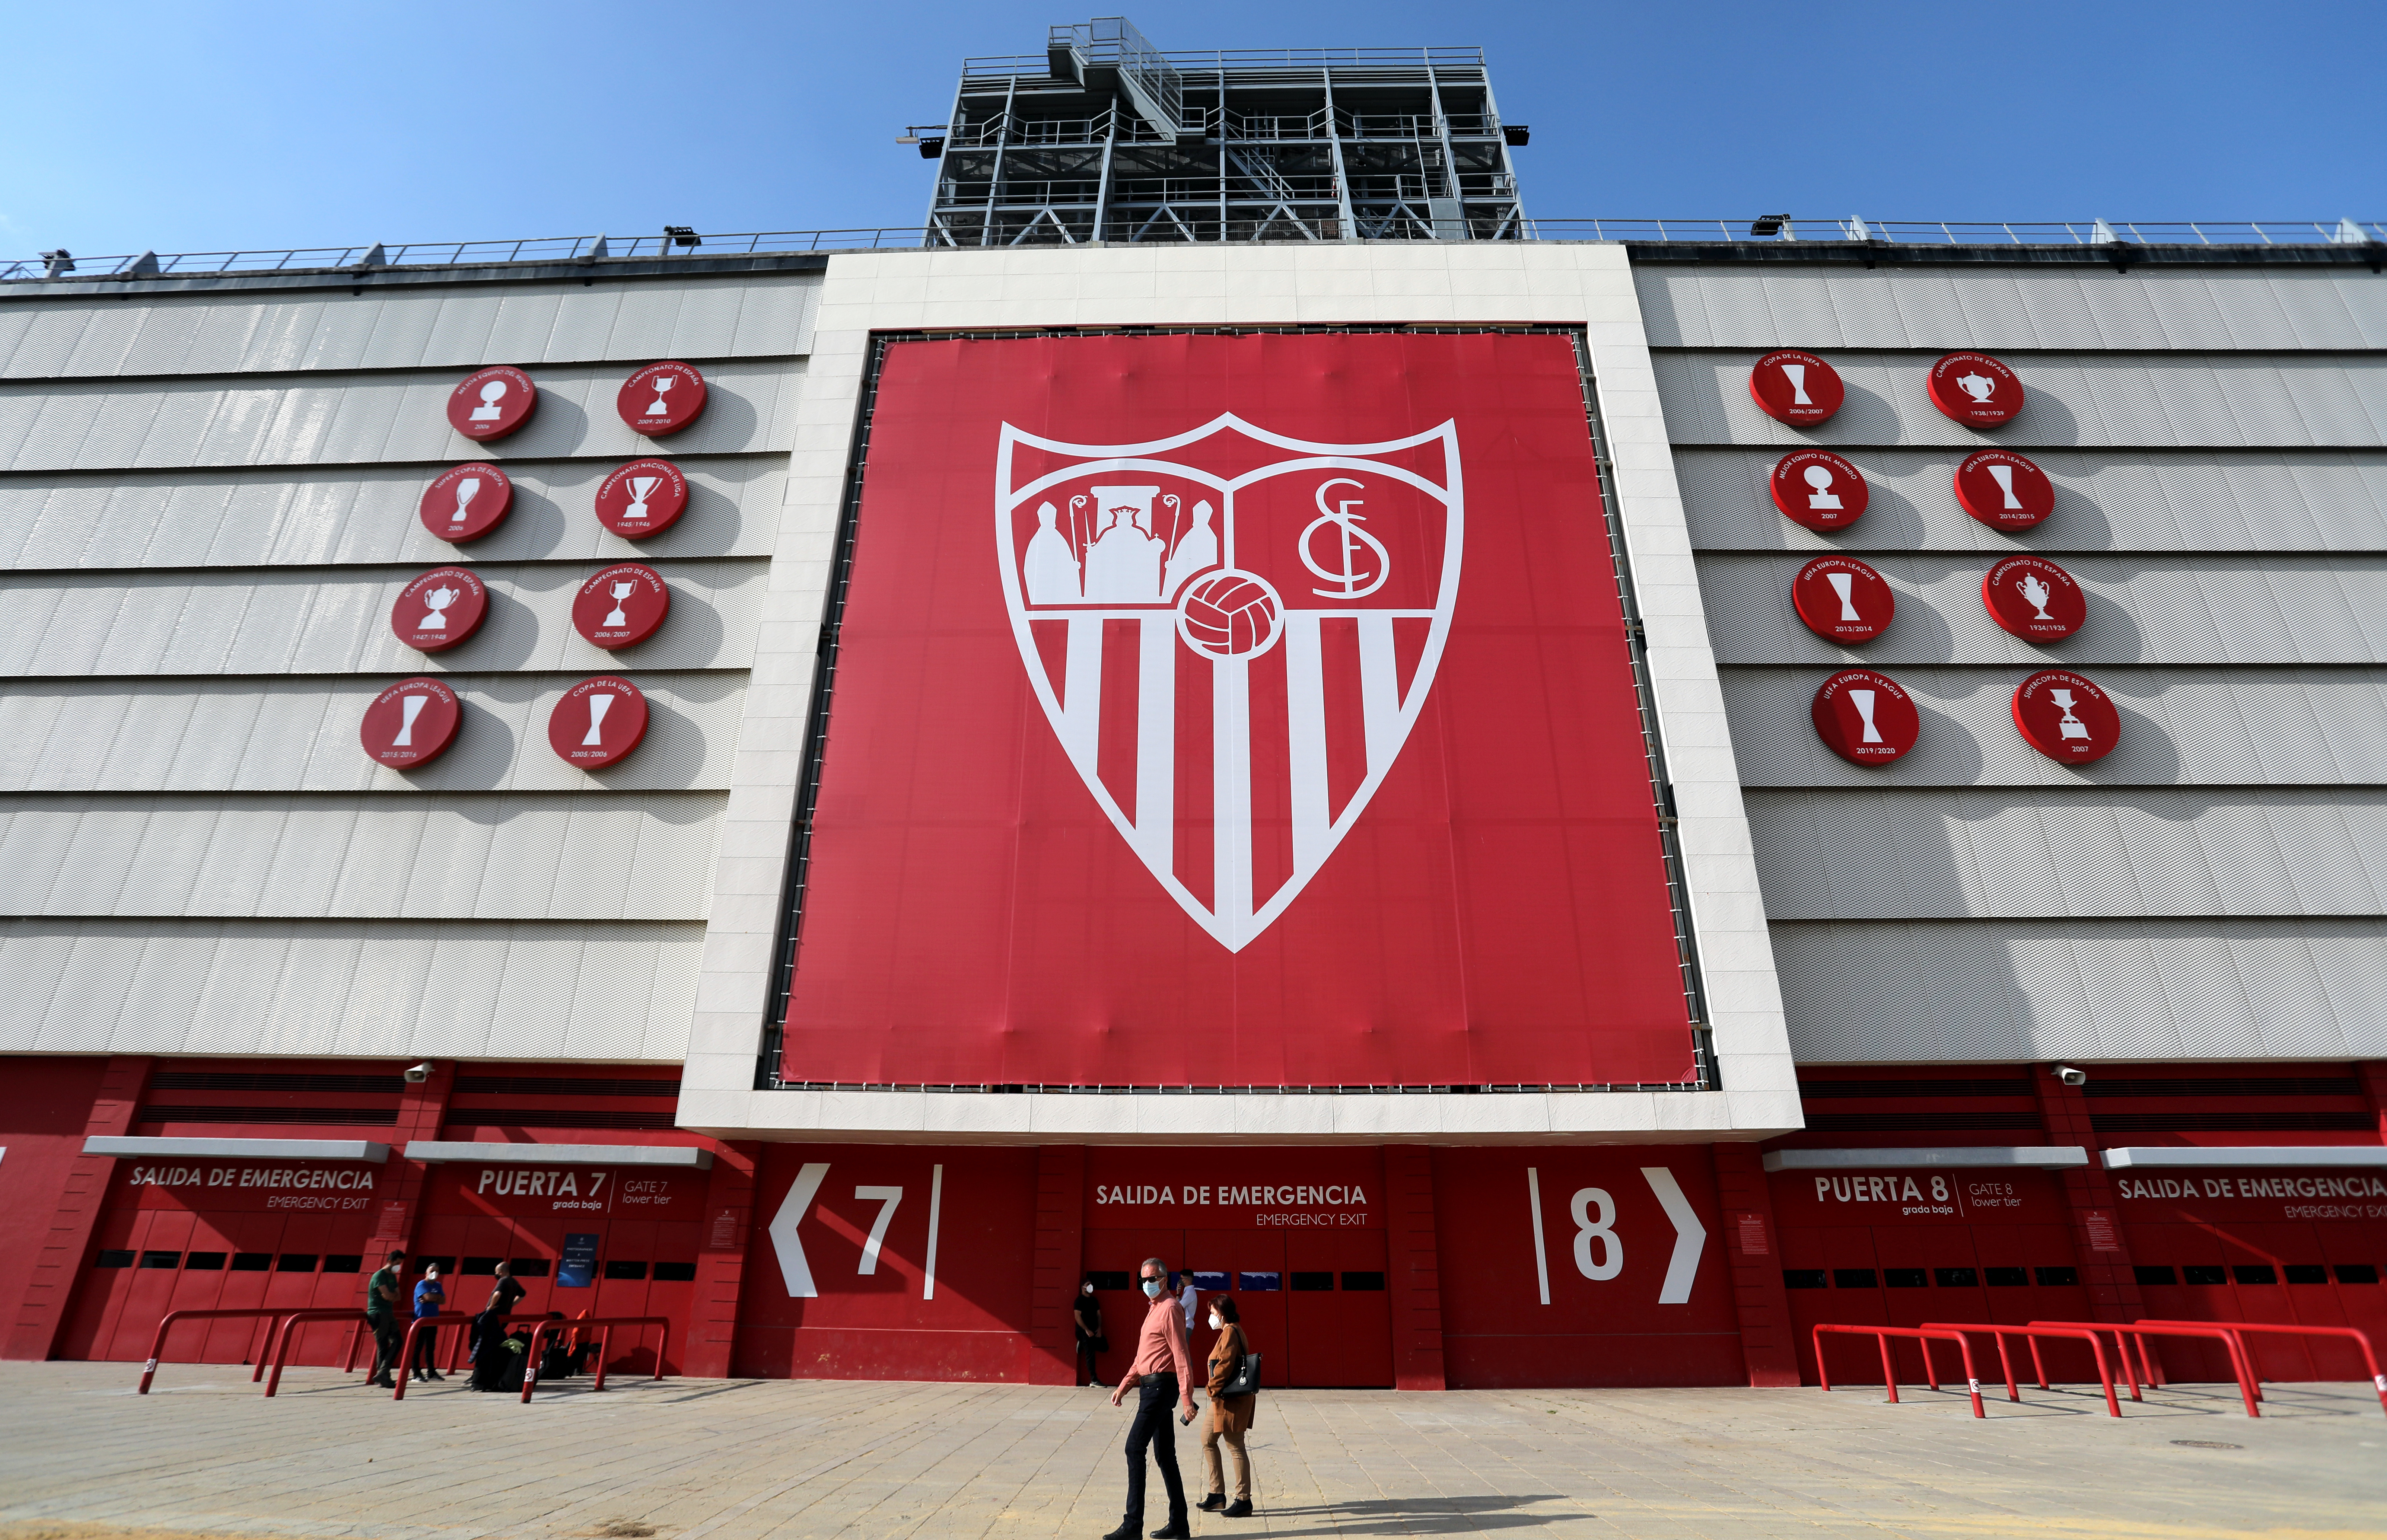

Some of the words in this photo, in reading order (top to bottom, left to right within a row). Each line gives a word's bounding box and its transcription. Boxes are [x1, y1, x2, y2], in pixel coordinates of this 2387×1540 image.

[1764, 356, 1781, 366] COPA
[1804, 357, 1820, 367] UEFA
[1936, 355, 1972, 377] CAMPEONATO
[1985, 360, 2009, 378] ESPAÑA
[478, 370, 504, 379] EQUIPO
[515, 374, 529, 392] MUNDO
[628, 365, 673, 387] CAMPEONATO
[683, 369, 699, 386] ESPAÑA
[1779, 461, 1793, 479] MEJOR
[1791, 453, 1817, 463] EQUIPO
[1833, 460, 1857, 479] MUNDO
[1966, 460, 1978, 472] UEFA
[1977, 454, 2005, 462] EUROPA
[2007, 456, 2034, 472] LEAGUE
[435, 474, 453, 489] SUPER
[486, 469, 503, 487] EUROPA
[601, 465, 639, 499] CAMPEONATO
[641, 463, 674, 476] NACIONAL
[585, 568, 632, 594] CAMPEONATO
[643, 572, 660, 593] ESPAÑA
[1804, 568, 1818, 580] UEFA
[1817, 561, 1846, 570] EUROPA
[1848, 562, 1876, 581] LEAGUE
[1993, 560, 2030, 586] CAMPEONATO
[2044, 565, 2071, 586] ESPAÑA
[405, 571, 453, 597] CAMPEONATO
[463, 575, 480, 596] ESPAÑA
[380, 690, 398, 704] UEFA
[400, 682, 429, 692] EUROPA
[429, 685, 451, 704] LEAGUE
[573, 683, 595, 696] COPA
[618, 683, 632, 696] UEFA
[1824, 683, 1838, 699] UEFA
[1839, 674, 1869, 684] EUROPA
[1874, 677, 1903, 699] LEAGUE
[2024, 675, 2057, 699] SUPERCOPA
[2071, 678, 2100, 699] ESPAÑA
[130, 1167, 201, 1186] SALIDA
[208, 1169, 235, 1187] DE
[239, 1169, 373, 1190] EMERGENCIA
[478, 1170, 577, 1196] PUERTA
[589, 1173, 606, 1197] 7
[625, 1181, 656, 1192] GATE
[659, 1182, 667, 1193] 7
[1815, 1177, 1923, 1202] PUERTA
[1931, 1176, 1949, 1201] 8
[1969, 1184, 2002, 1195] GATE
[2005, 1183, 2012, 1195] 8
[2119, 1179, 2200, 1199] SALIDA
[2203, 1179, 2234, 1197] DE
[2237, 1178, 2387, 1197] EMERGENCIA
[267, 1196, 340, 1209] EMERGENCY
[342, 1198, 370, 1209] EXIT
[553, 1200, 579, 1210] grada
[581, 1200, 602, 1211] baja
[623, 1194, 651, 1204] lower
[653, 1195, 671, 1204] tier
[1096, 1186, 1175, 1205] SALIDA
[1184, 1186, 1210, 1205] DE
[1219, 1186, 1366, 1205] EMERGENCIA
[1971, 1196, 2003, 1206] lower
[2006, 1196, 2021, 1206] tier
[1257, 1214, 1335, 1225] EMERGENCY
[1340, 1214, 1367, 1225] EXIT
[1902, 1205, 1930, 1215] grada
[1932, 1205, 1953, 1214] baja
[2285, 1206, 2363, 1218] EMERGENCY
[854, 1186, 903, 1275] 7
[1571, 1188, 1623, 1281] 8
